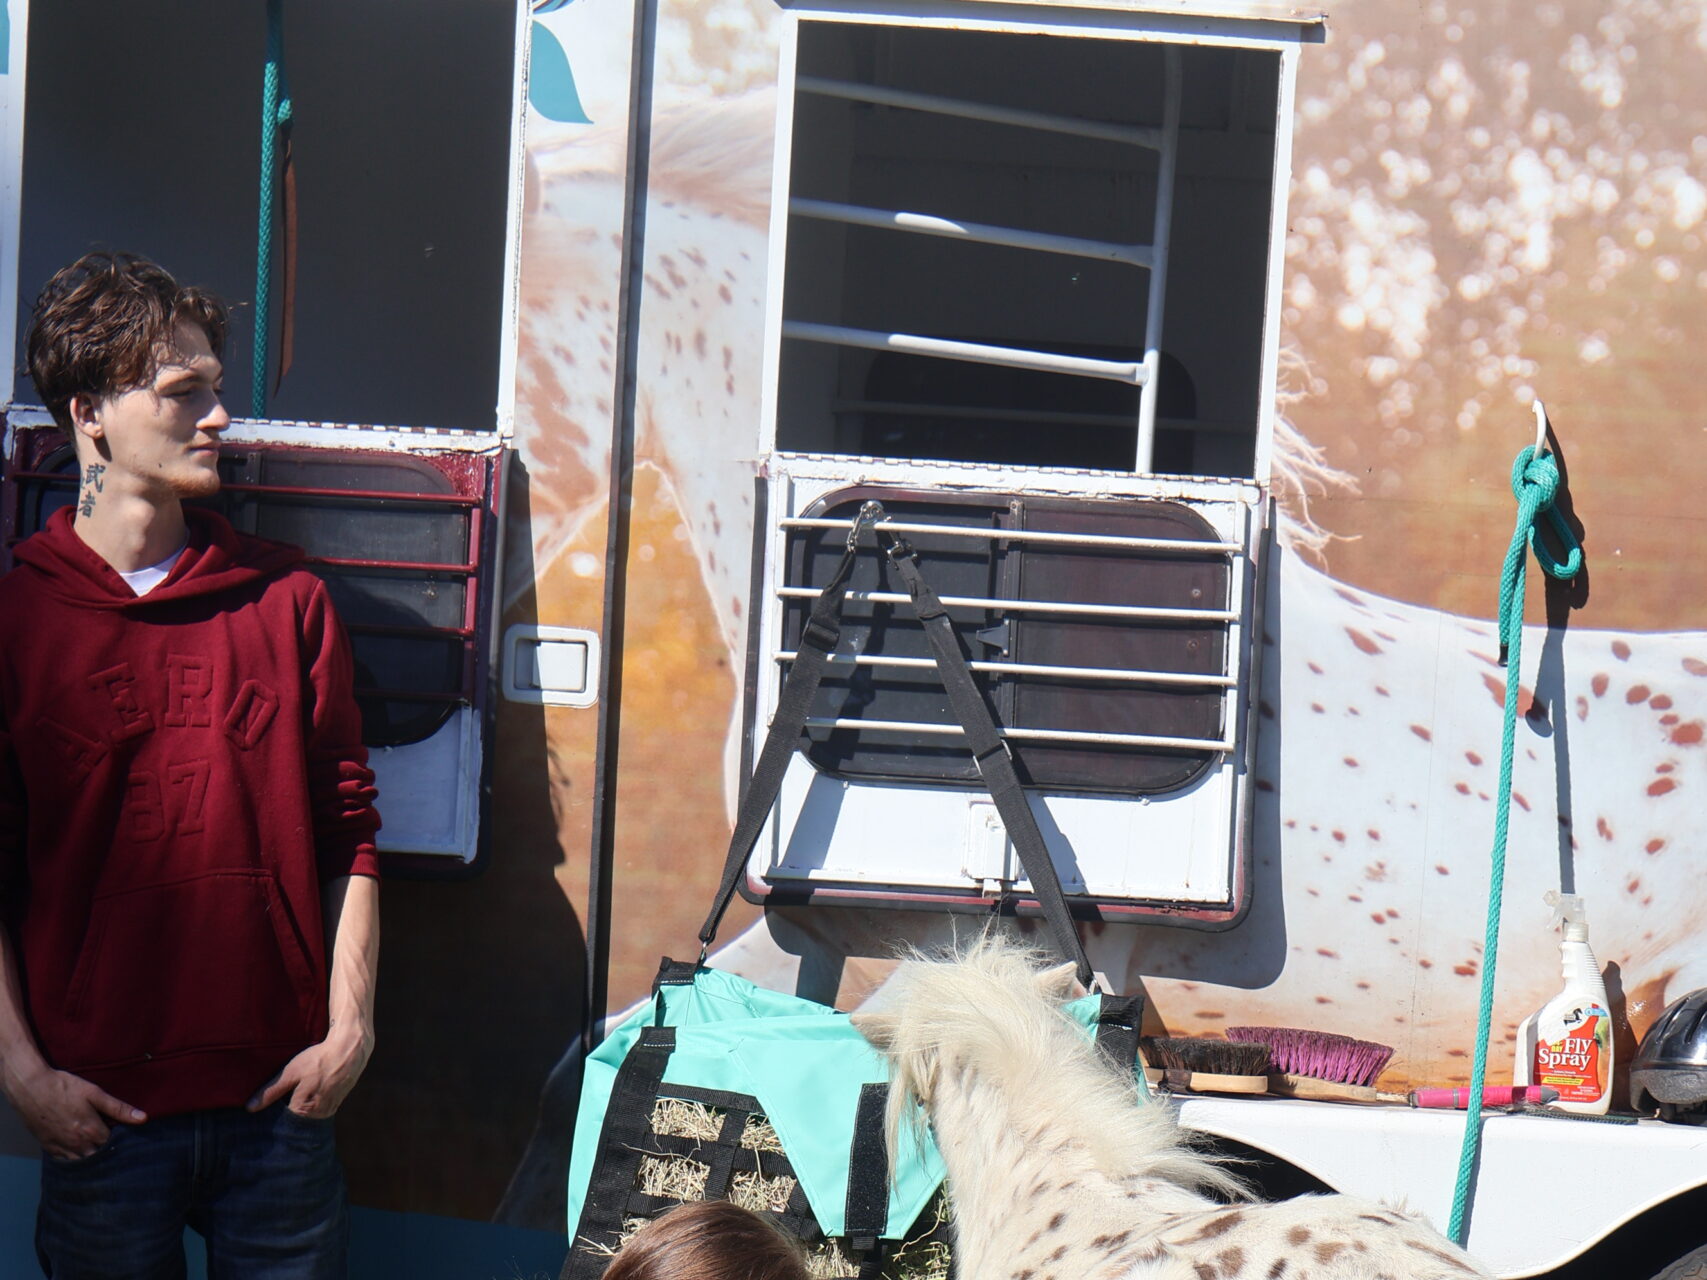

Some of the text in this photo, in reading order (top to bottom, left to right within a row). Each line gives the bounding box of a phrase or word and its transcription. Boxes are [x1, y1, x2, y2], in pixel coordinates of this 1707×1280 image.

[35, 653, 280, 789] AERO
[1564, 1038, 1593, 1055] Fly
[1539, 1048, 1591, 1070] Spray
